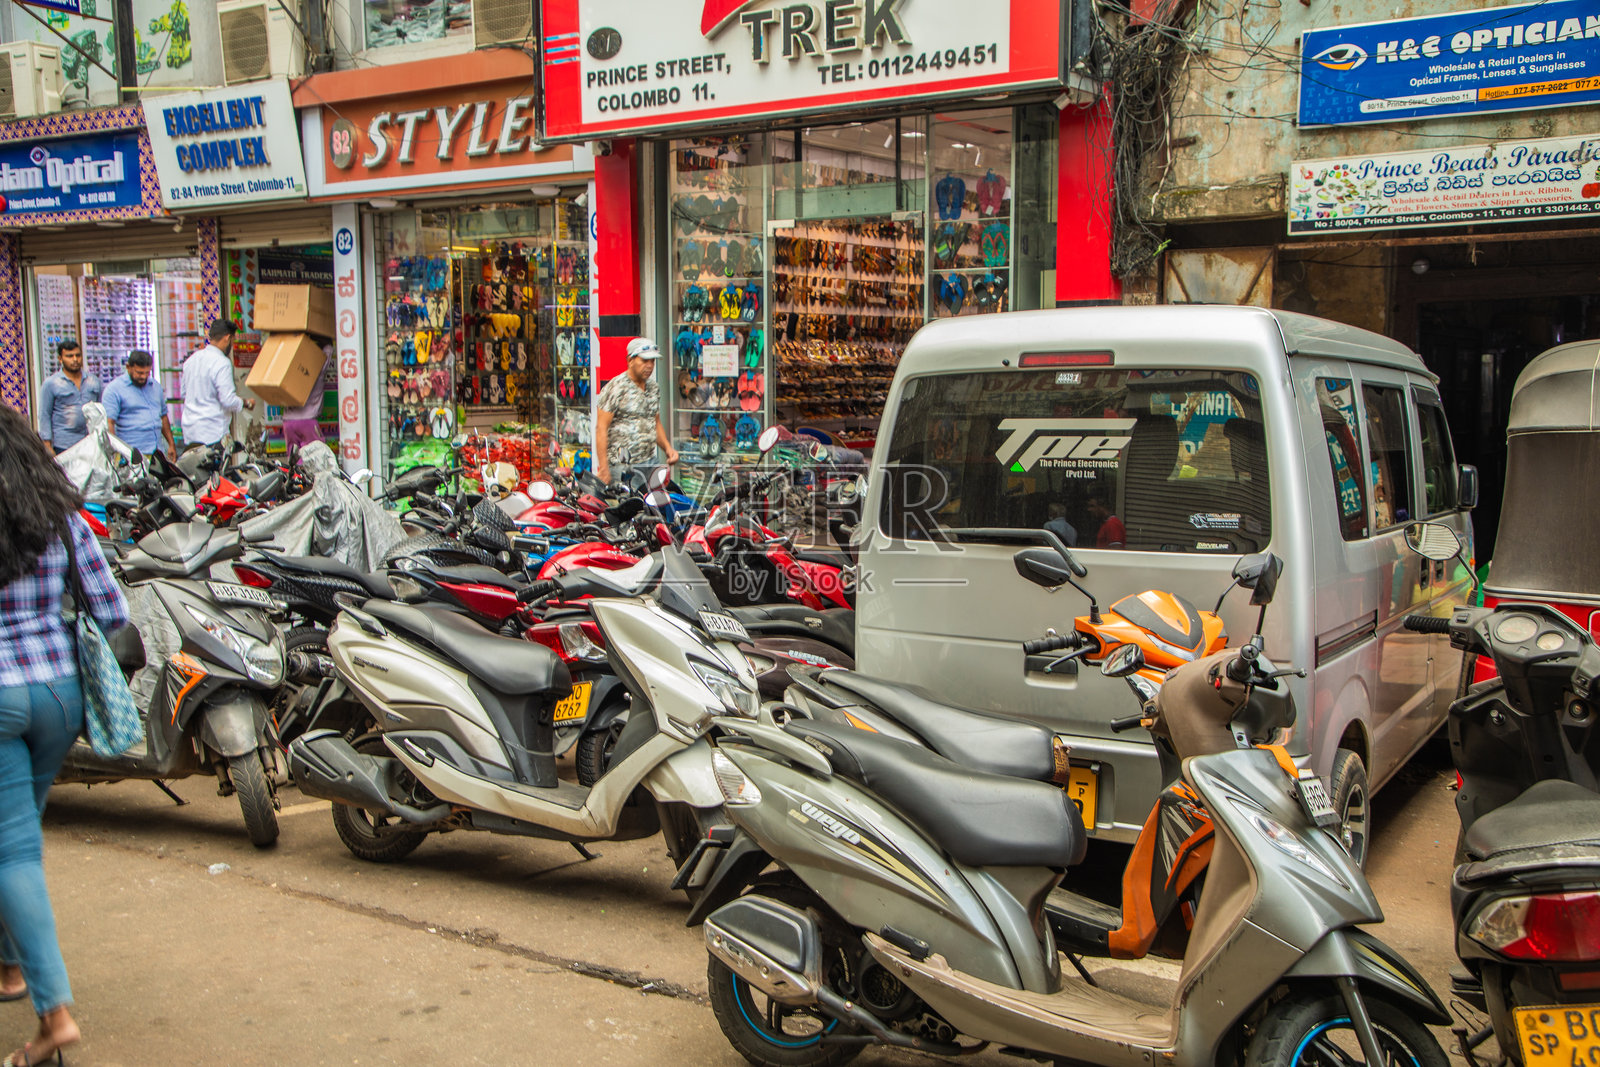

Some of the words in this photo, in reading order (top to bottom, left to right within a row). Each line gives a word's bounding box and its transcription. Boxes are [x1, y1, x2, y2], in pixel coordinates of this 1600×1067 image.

[740, 0, 912, 63] TREK
[1376, 36, 1441, 63] K&C
[587, 65, 648, 88] PRINCE
[656, 53, 731, 78] STREET,
[1410, 76, 1442, 88] Optical
[1444, 73, 1480, 84] Frames,
[1483, 68, 1516, 79] Lenses
[1519, 66, 1527, 75] &
[1529, 60, 1586, 74] Sunglasses
[1429, 62, 1476, 74] Wholesale
[1478, 60, 1485, 68] &
[1488, 57, 1515, 67] Retail
[1517, 53, 1553, 64] Dealers
[1556, 51, 1566, 60] in
[598, 87, 680, 112] COLOMBO
[692, 82, 715, 101] 11.
[1485, 89, 1509, 98] Hotline
[1513, 87, 1528, 95] 077
[1575, 80, 1590, 88] 077
[1387, 99, 1406, 108] Prince
[1430, 95, 1460, 104] Colombo
[163, 96, 265, 137] EXCELLENT
[332, 130, 350, 155] 82
[362, 95, 546, 168] STYLE
[176, 136, 270, 173] COMPLEX
[47, 151, 124, 193] Optical
[1357, 159, 1422, 180] Prince
[170, 186, 195, 200] 82-84,
[194, 183, 220, 197] Prince
[221, 181, 248, 195] Street,
[248, 176, 295, 192] Colombo-11
[1391, 195, 1430, 205] Wholesale
[1433, 194, 1440, 202] &
[1443, 192, 1466, 201] Retail
[1469, 189, 1499, 199] Dealers
[1502, 189, 1510, 197] in
[1513, 189, 1535, 198] Lace,
[1538, 185, 1573, 195] Ribbon,
[1416, 202, 1450, 212] Flowers,
[1451, 200, 1478, 209] Stones
[1480, 199, 1487, 207] &
[1490, 197, 1520, 207] Slipper
[1523, 194, 1575, 204] Accessories.
[1314, 220, 1328, 228] No
[1335, 218, 1362, 228] 80/04,
[1363, 216, 1394, 225] Prince
[1395, 214, 1427, 224] Street,
[1429, 211, 1474, 221] Colombo
[1482, 209, 1497, 218] 11.
[1499, 207, 1515, 216] Tel
[1524, 206, 1542, 215] 011
[1545, 203, 1592, 213] 3301442,
[338, 232, 351, 250] 82
[301, 271, 333, 280] TRADERS
[1040, 459, 1052, 468] The
[1053, 459, 1076, 468] Prince
[1078, 459, 1118, 469] Electronics
[555, 702, 582, 719] 6767
[1529, 1033, 1560, 1056] SP
